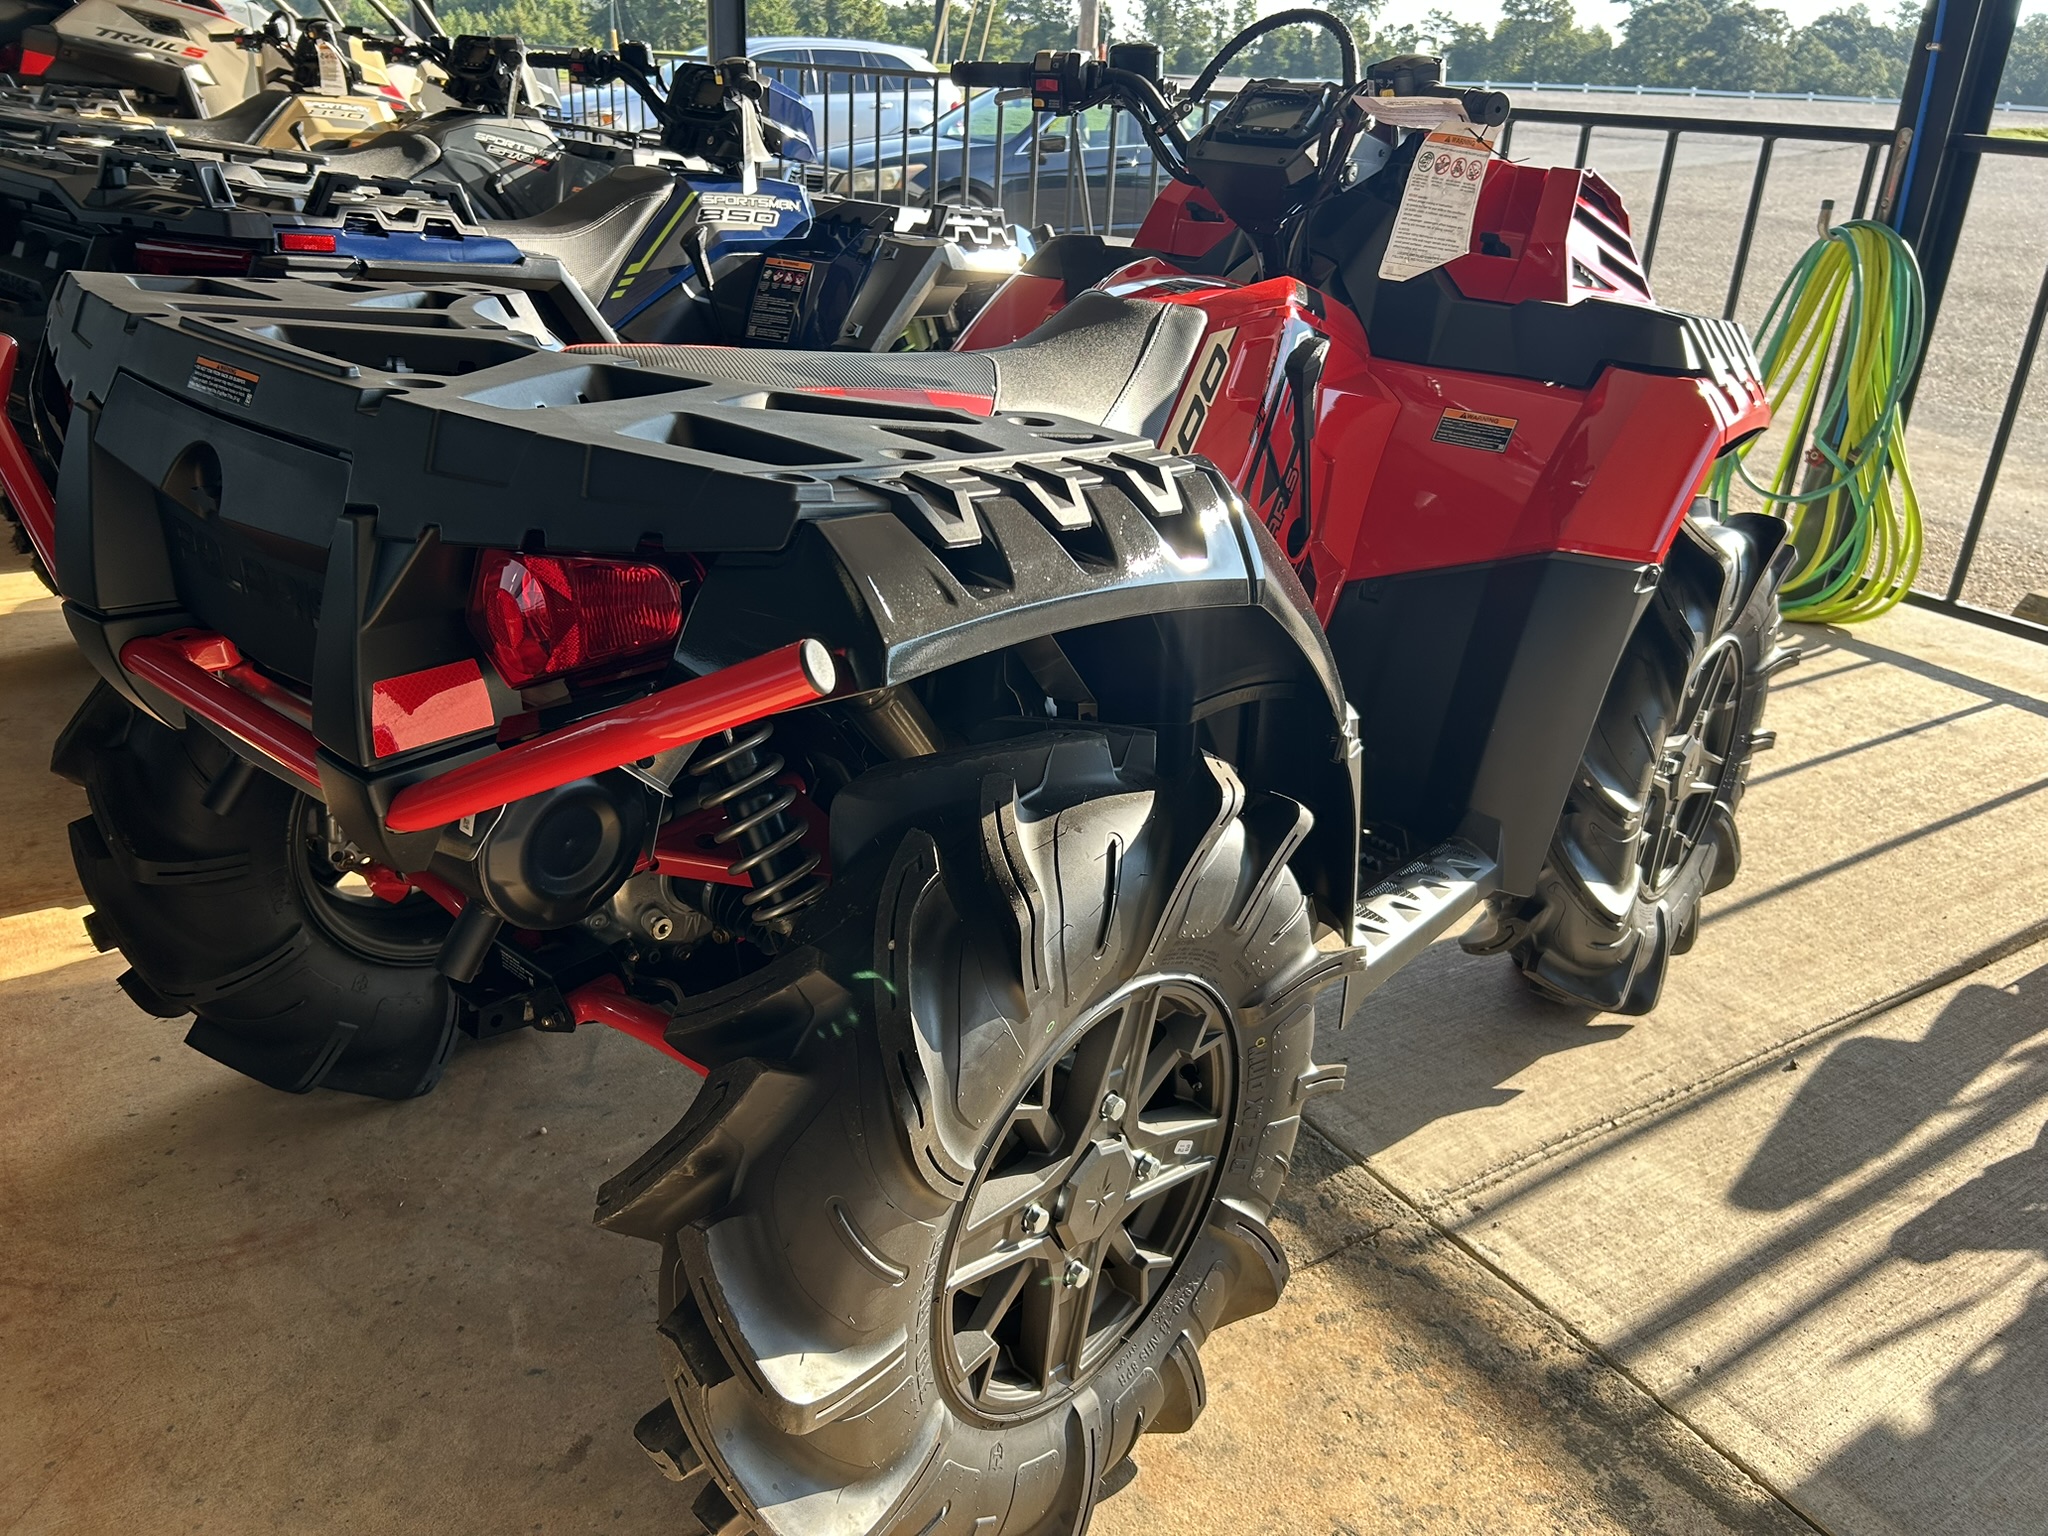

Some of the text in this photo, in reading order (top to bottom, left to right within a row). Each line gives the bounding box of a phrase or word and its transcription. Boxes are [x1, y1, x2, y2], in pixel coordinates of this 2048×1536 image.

[96, 27, 208, 58] TRAIL S
[702, 195, 801, 212] SPORTSMAN
[696, 207, 780, 226] 850
[1467, 413, 1500, 424] WARNING
